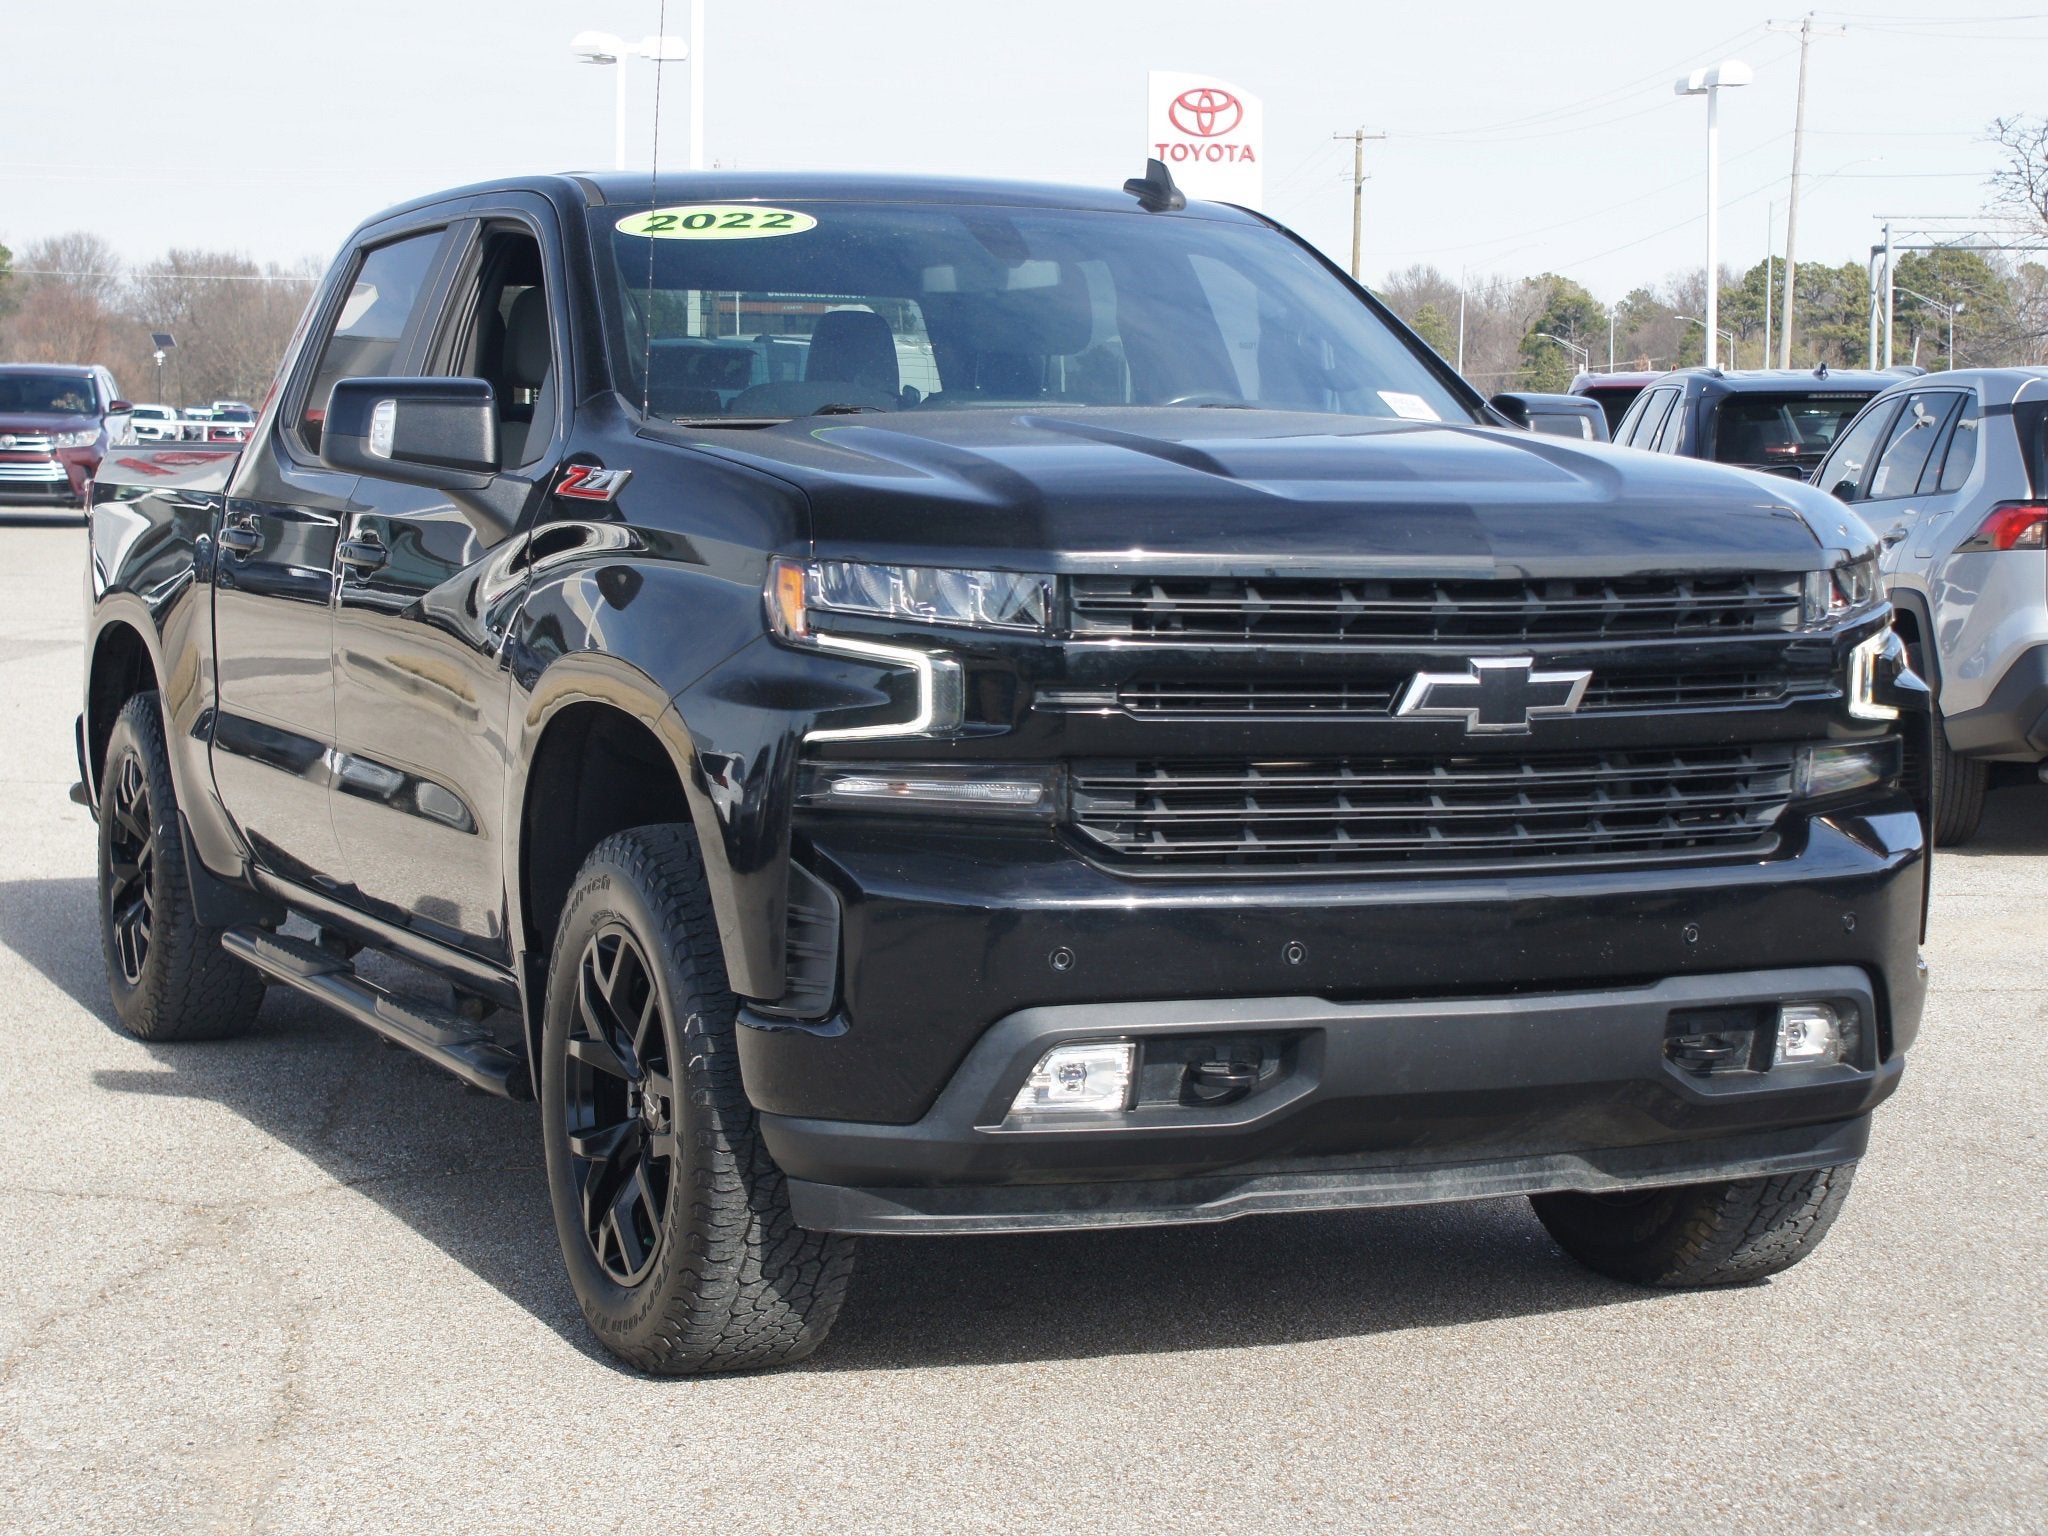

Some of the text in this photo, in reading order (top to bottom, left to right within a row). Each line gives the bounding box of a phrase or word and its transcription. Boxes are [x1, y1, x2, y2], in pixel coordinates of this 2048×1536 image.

[1154, 143, 1256, 163] TOYOTA
[640, 212, 796, 233] 2022
[554, 463, 632, 502] Z71
